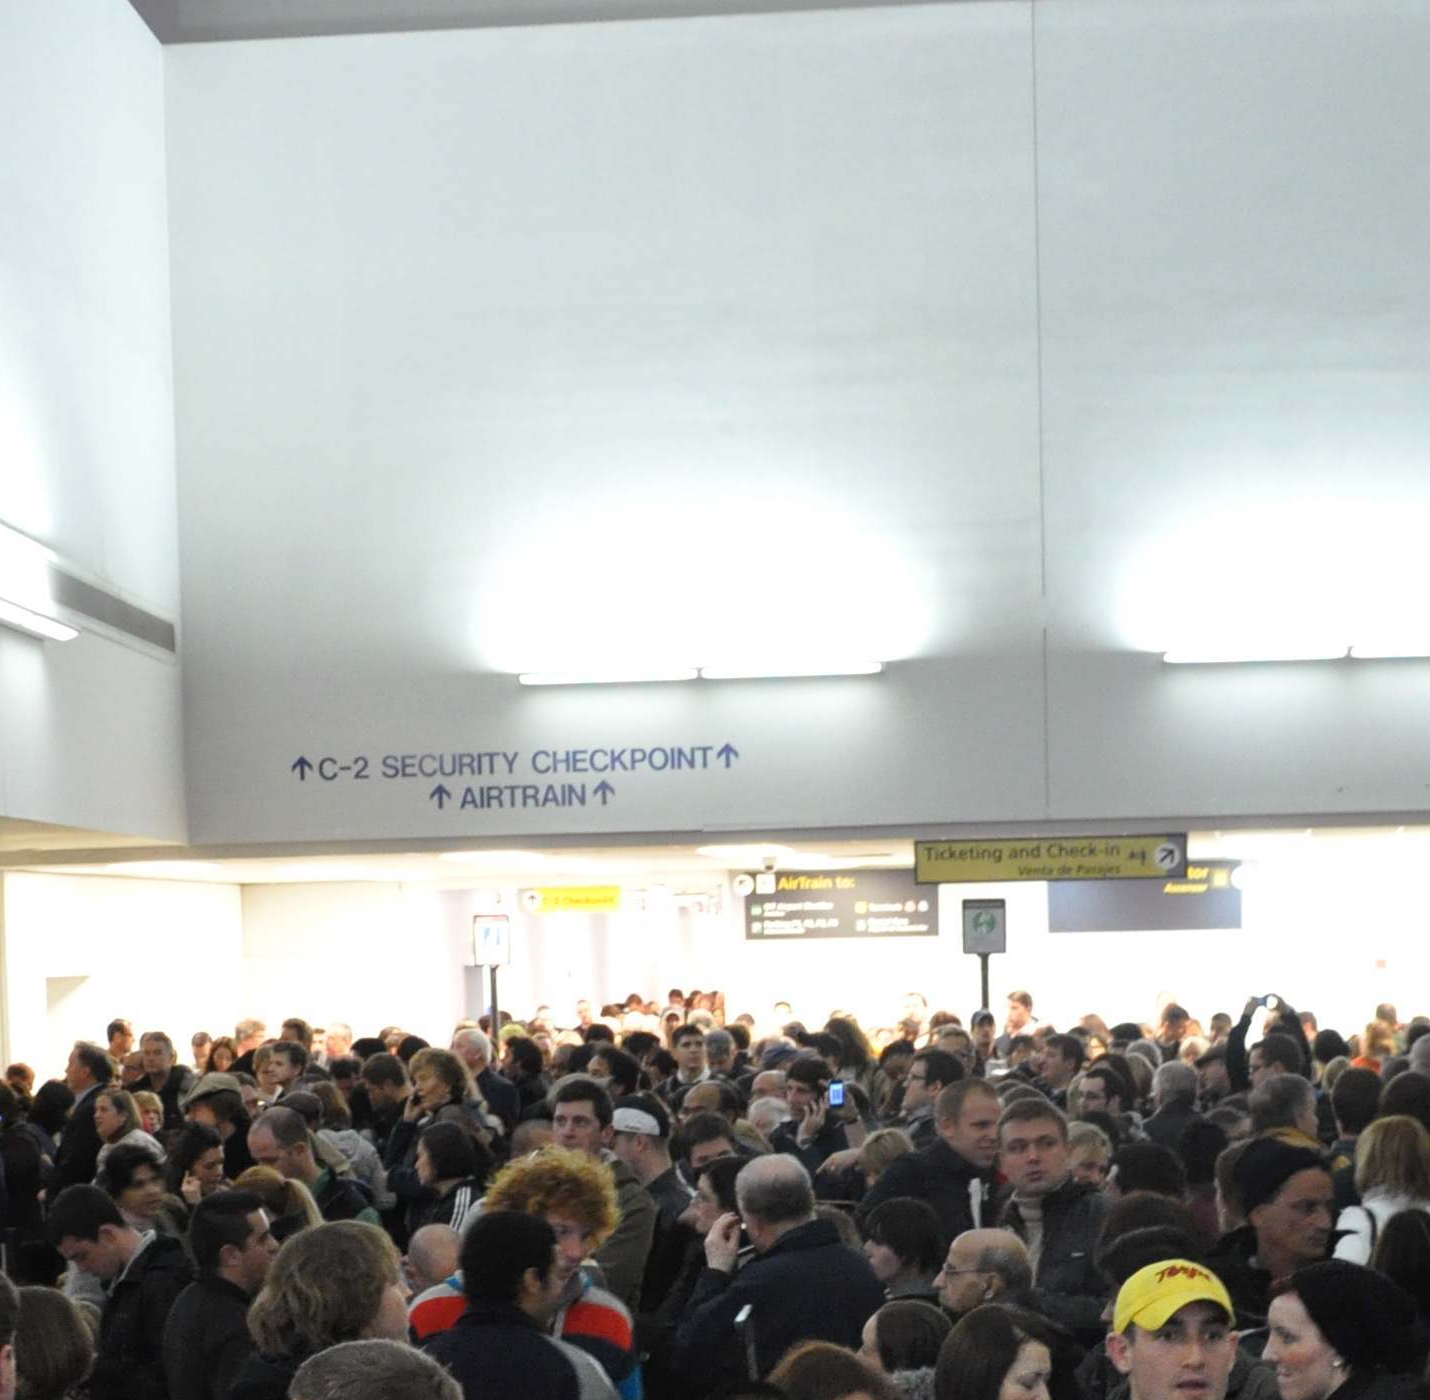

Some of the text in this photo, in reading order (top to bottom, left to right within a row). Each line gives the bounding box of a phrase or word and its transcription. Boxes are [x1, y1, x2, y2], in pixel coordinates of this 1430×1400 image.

[318, 745, 714, 781] C-2 SECURITY CHECKPOINT
[460, 783, 587, 809] AIRTRAIN
[924, 845, 1003, 862] Ticketing
[1008, 843, 1042, 859] and
[777, 875, 833, 891] AirTrain
